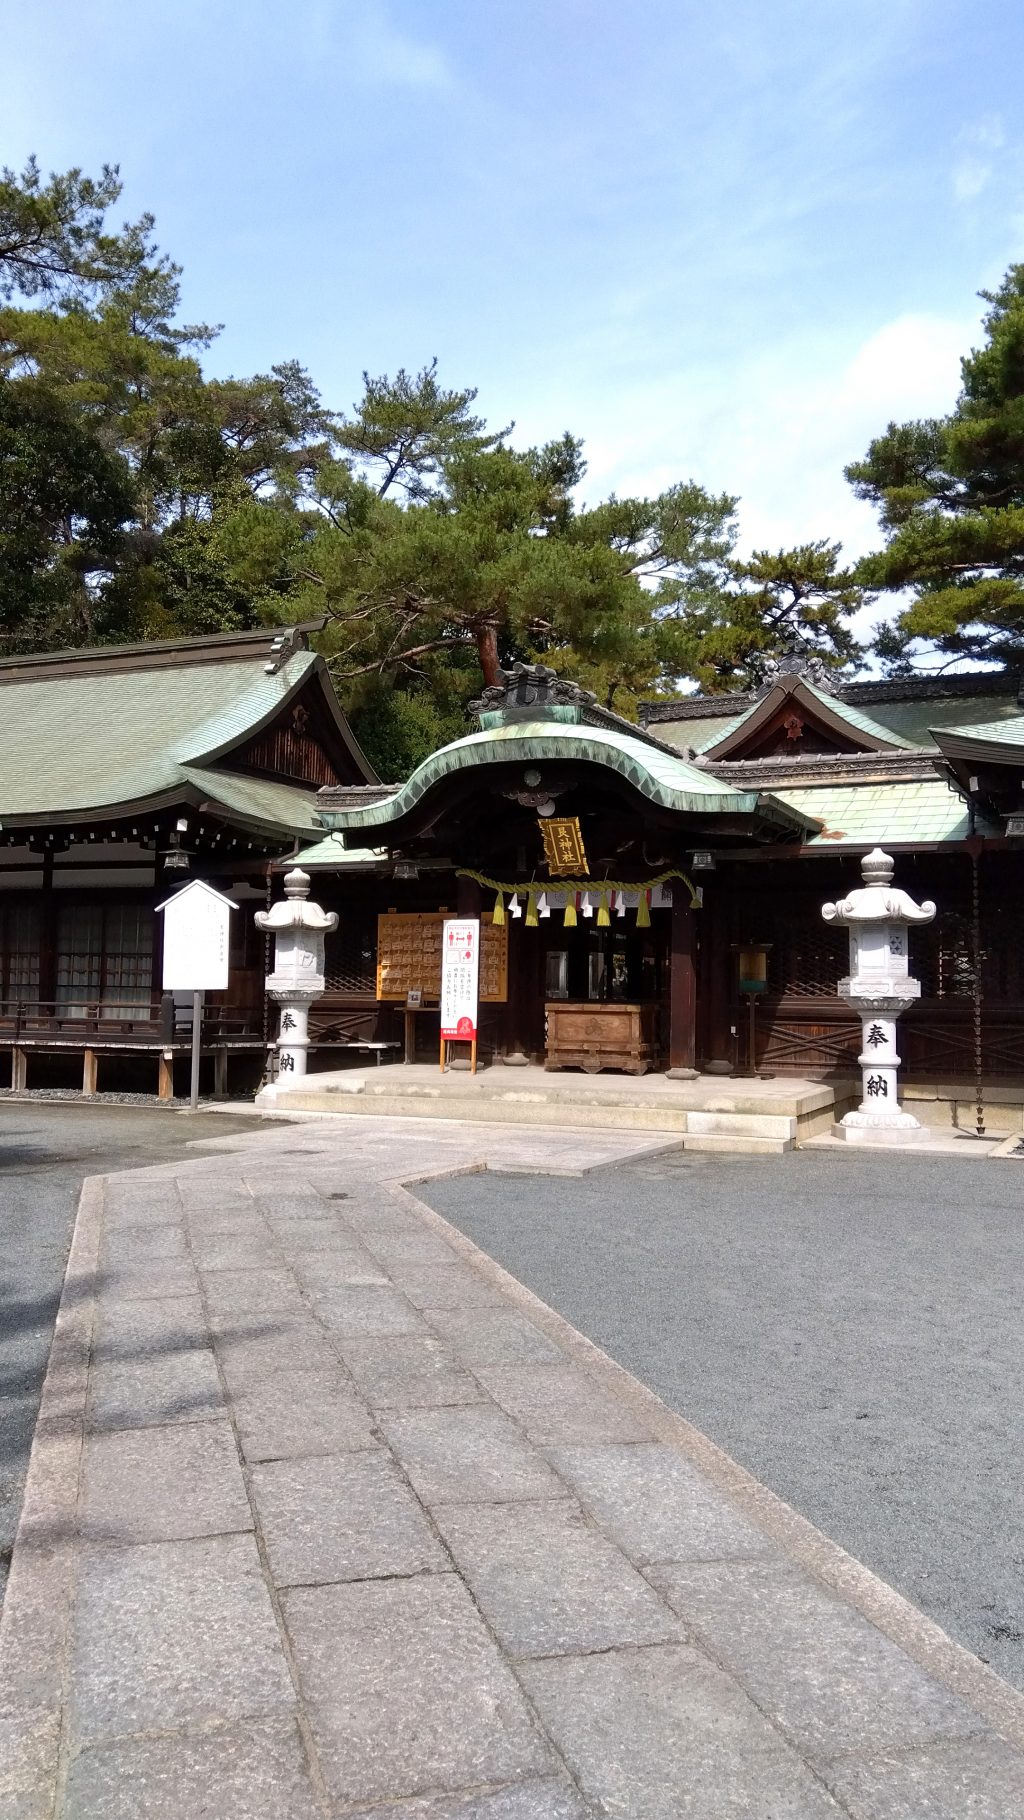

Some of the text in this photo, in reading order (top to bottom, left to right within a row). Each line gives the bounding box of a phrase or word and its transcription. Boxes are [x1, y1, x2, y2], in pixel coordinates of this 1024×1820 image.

[557, 827, 576, 863] 艮神社
[279, 1012, 297, 1072] 奉納
[866, 1024, 889, 1098] 奉納
